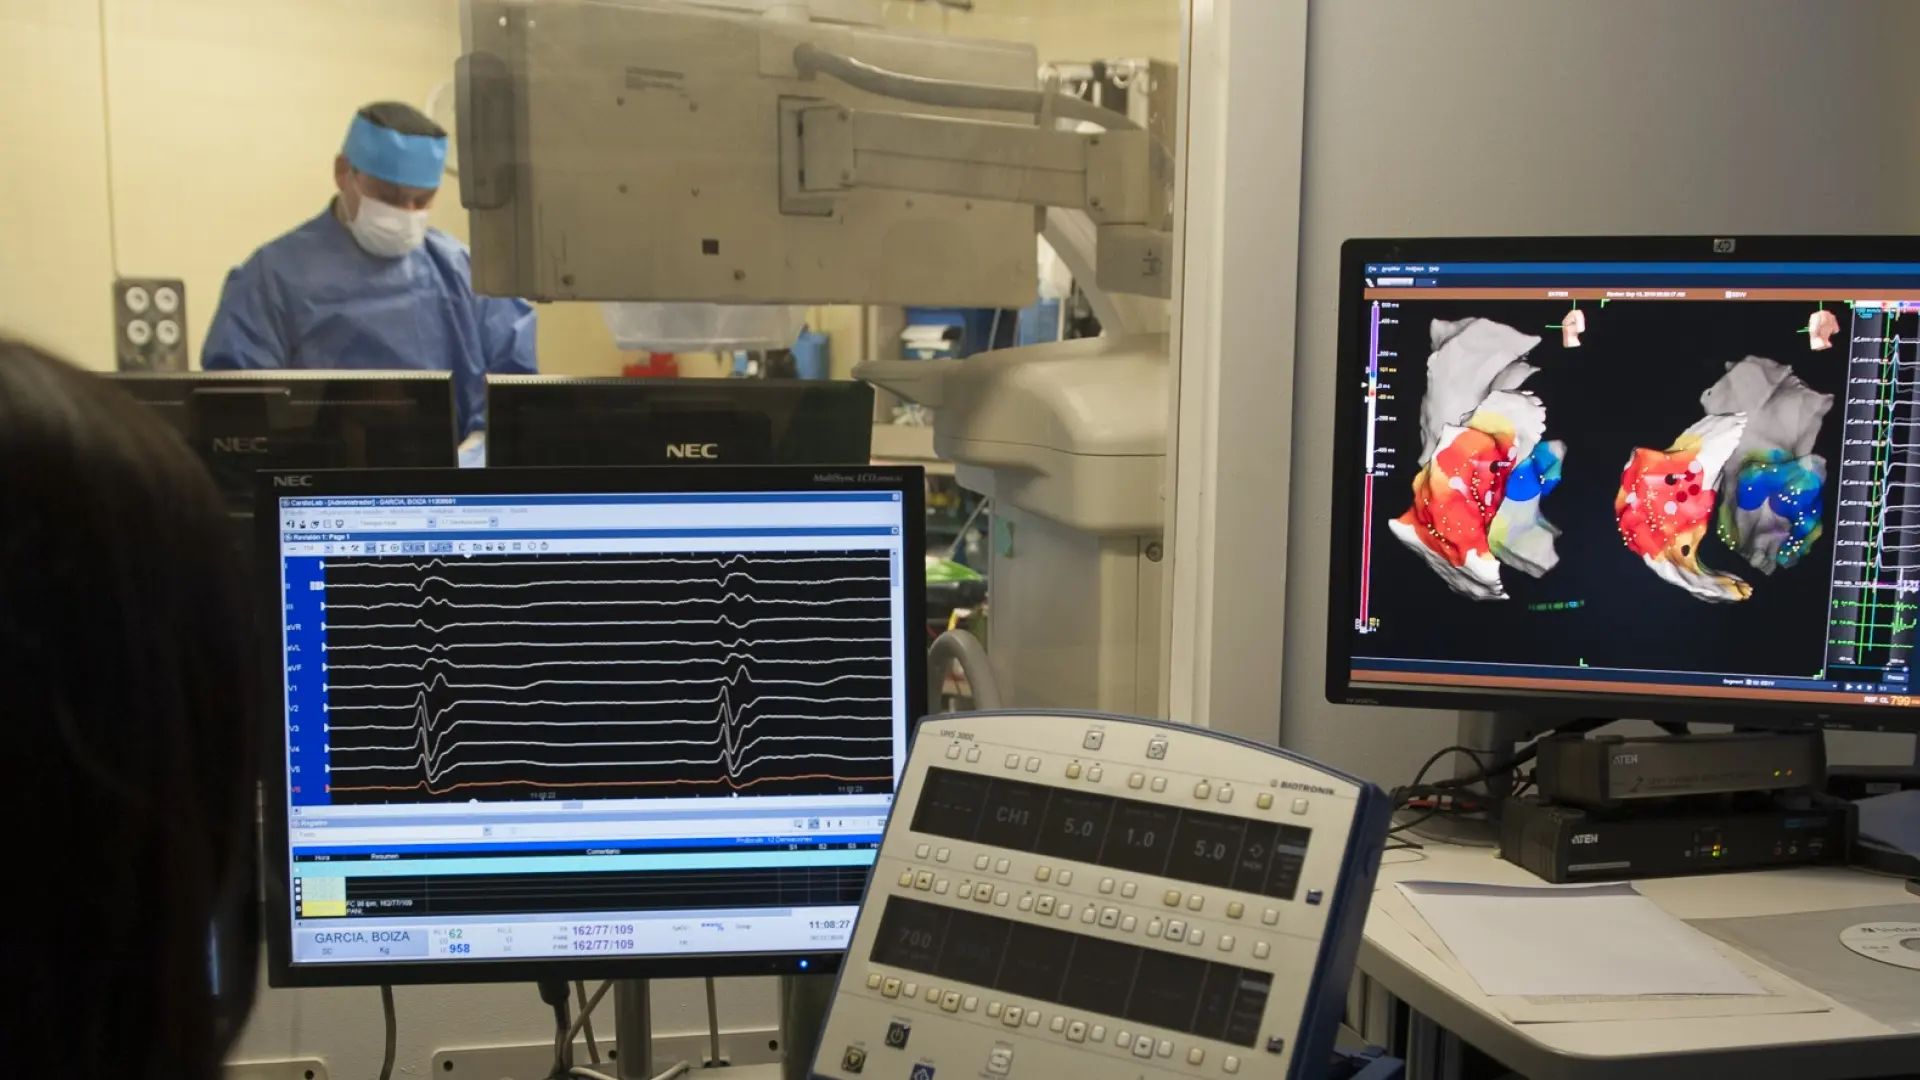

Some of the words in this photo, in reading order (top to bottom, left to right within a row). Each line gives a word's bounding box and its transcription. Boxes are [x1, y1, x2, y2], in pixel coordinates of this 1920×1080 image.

[213, 436, 268, 453] NEC
[666, 443, 718, 459] NEC
[273, 475, 313, 487] NEC
[814, 472, 855, 484] MultiSync
[1890, 695, 1911, 706] 799
[1613, 753, 1638, 765] ATEN
[1280, 780, 1335, 796] BIOTRONIK
[996, 805, 1029, 826] CH1
[1063, 816, 1094, 837] 5.0
[1126, 827, 1155, 848] 1.0
[1571, 833, 1598, 844] ATEN
[1193, 839, 1226, 861] 5.0
[572, 924, 634, 936] 162/77/109
[809, 920, 850, 929] 11:08:27
[314, 932, 368, 944] GARCIA,
[372, 931, 411, 942] BOIZA
[448, 928, 463, 939] 62
[899, 926, 933, 949] 700
[379, 946, 390, 955] Kg
[449, 943, 471, 953] 958
[572, 939, 634, 951] 162/77/109
